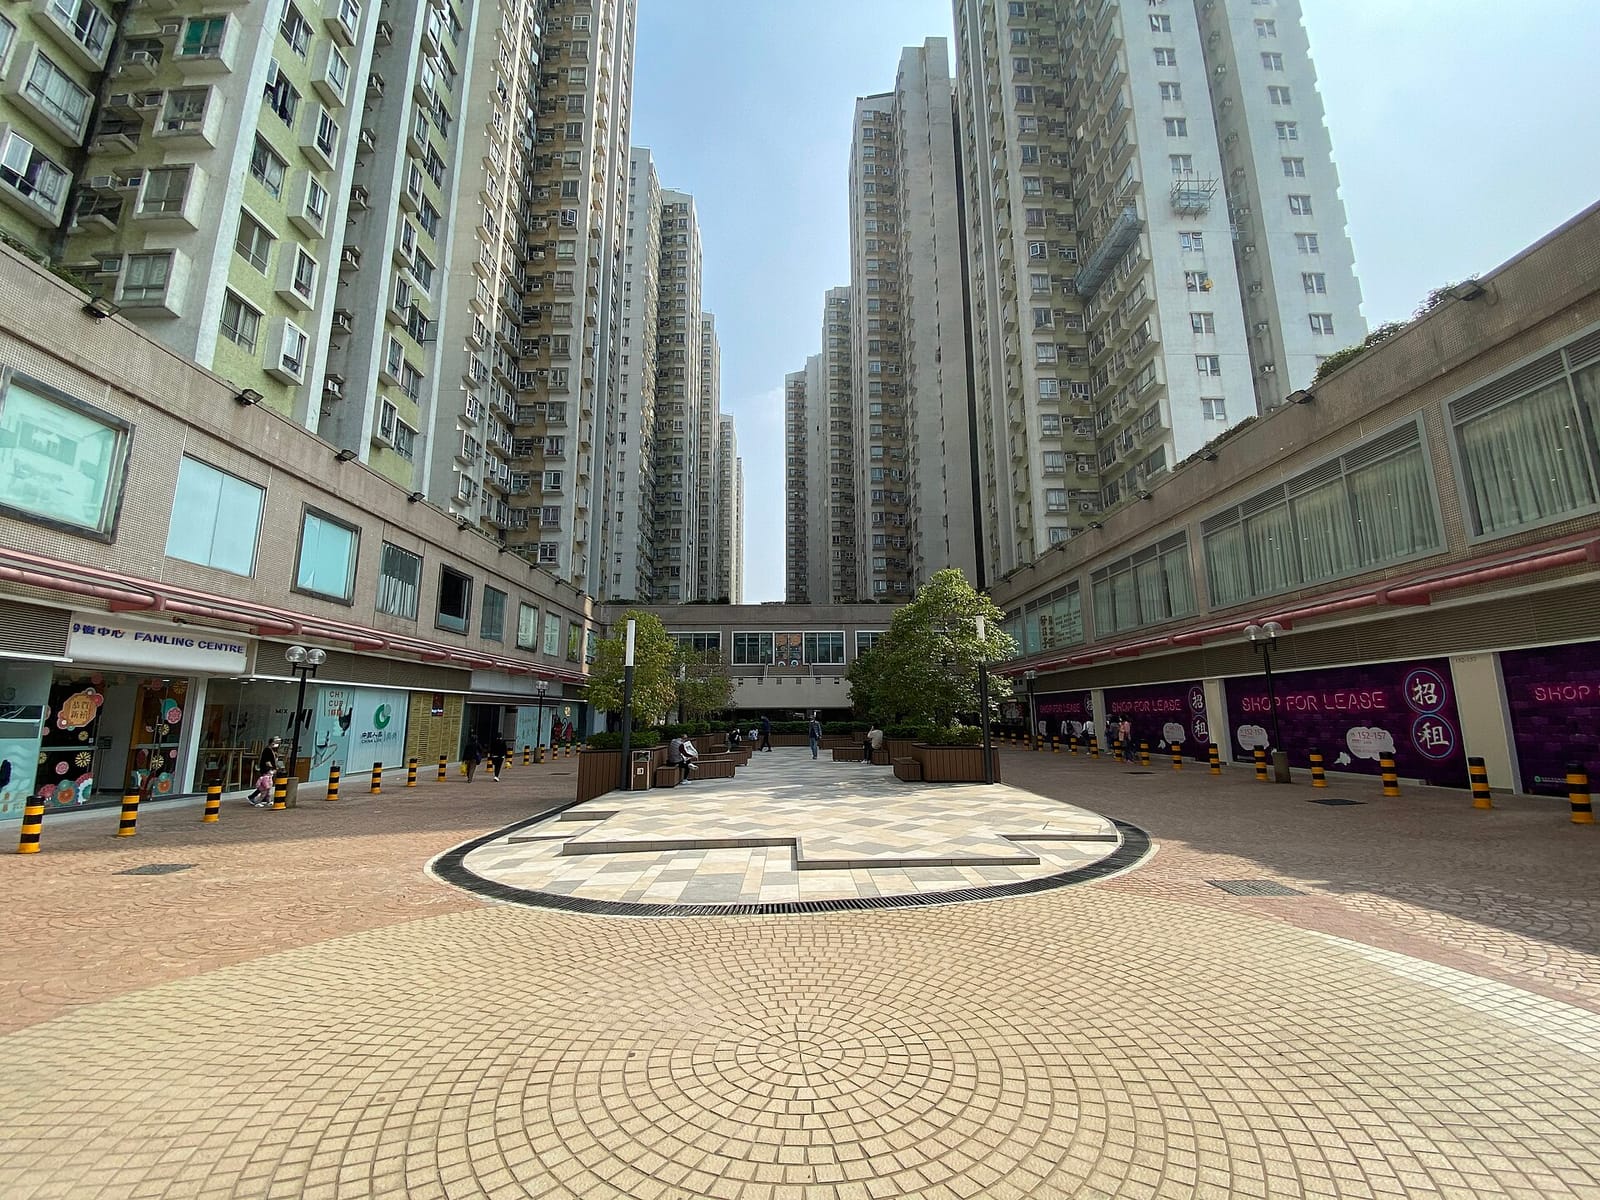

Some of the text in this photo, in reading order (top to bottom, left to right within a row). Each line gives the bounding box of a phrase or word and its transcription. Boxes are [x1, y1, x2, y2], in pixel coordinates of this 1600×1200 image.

[134, 632, 244, 654] FANLING CENTRE
[1242, 691, 1385, 712] SHOP FOR LEASE
[1534, 685, 1590, 701] SHOP
[1112, 699, 1181, 713] SHOP FOR LEASE
